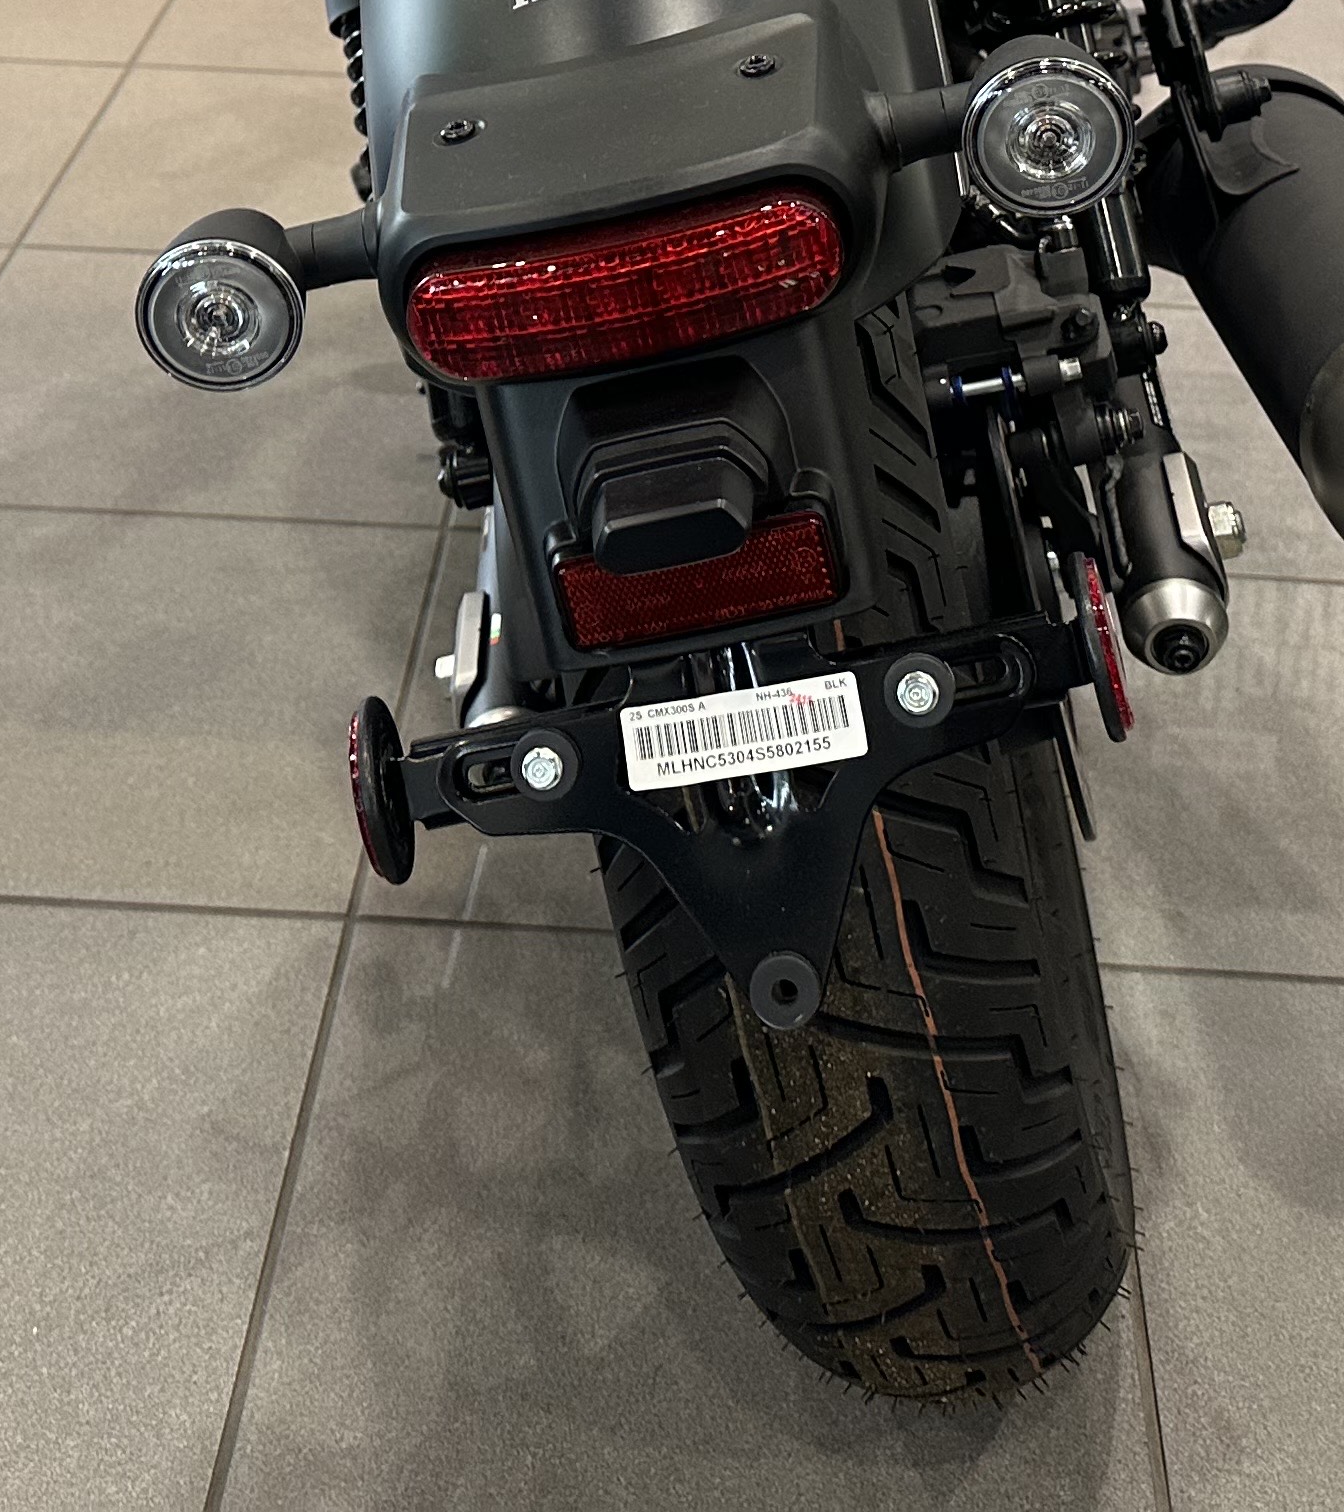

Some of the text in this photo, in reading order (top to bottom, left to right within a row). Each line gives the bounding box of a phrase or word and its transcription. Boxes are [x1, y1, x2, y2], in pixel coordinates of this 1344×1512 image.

[824, 678, 847, 690] BLK
[647, 704, 695, 719] CMX300S
[698, 701, 706, 711] A
[657, 736, 832, 776] MLHNC5304S5802155
